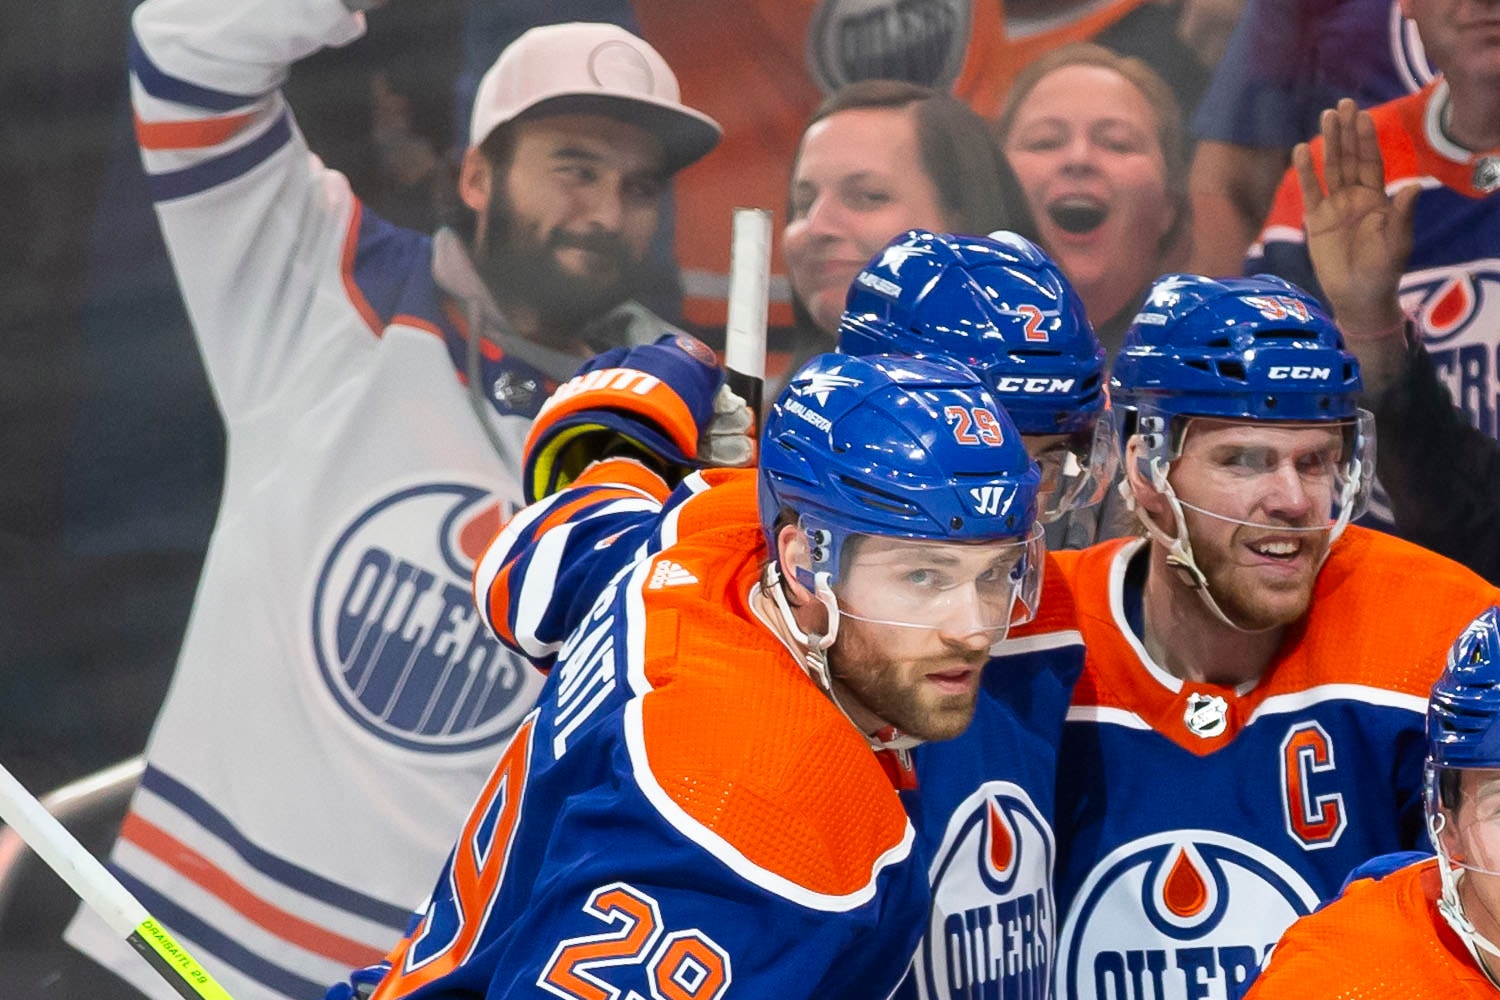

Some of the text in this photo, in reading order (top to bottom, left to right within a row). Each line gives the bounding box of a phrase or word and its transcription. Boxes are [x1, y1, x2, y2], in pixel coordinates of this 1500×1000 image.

[1017, 303, 1050, 343] 2
[996, 377, 1076, 393] CCM
[1267, 366, 1332, 380] CCM
[1279, 719, 1348, 851] C
[943, 887, 1047, 995] OILERS
